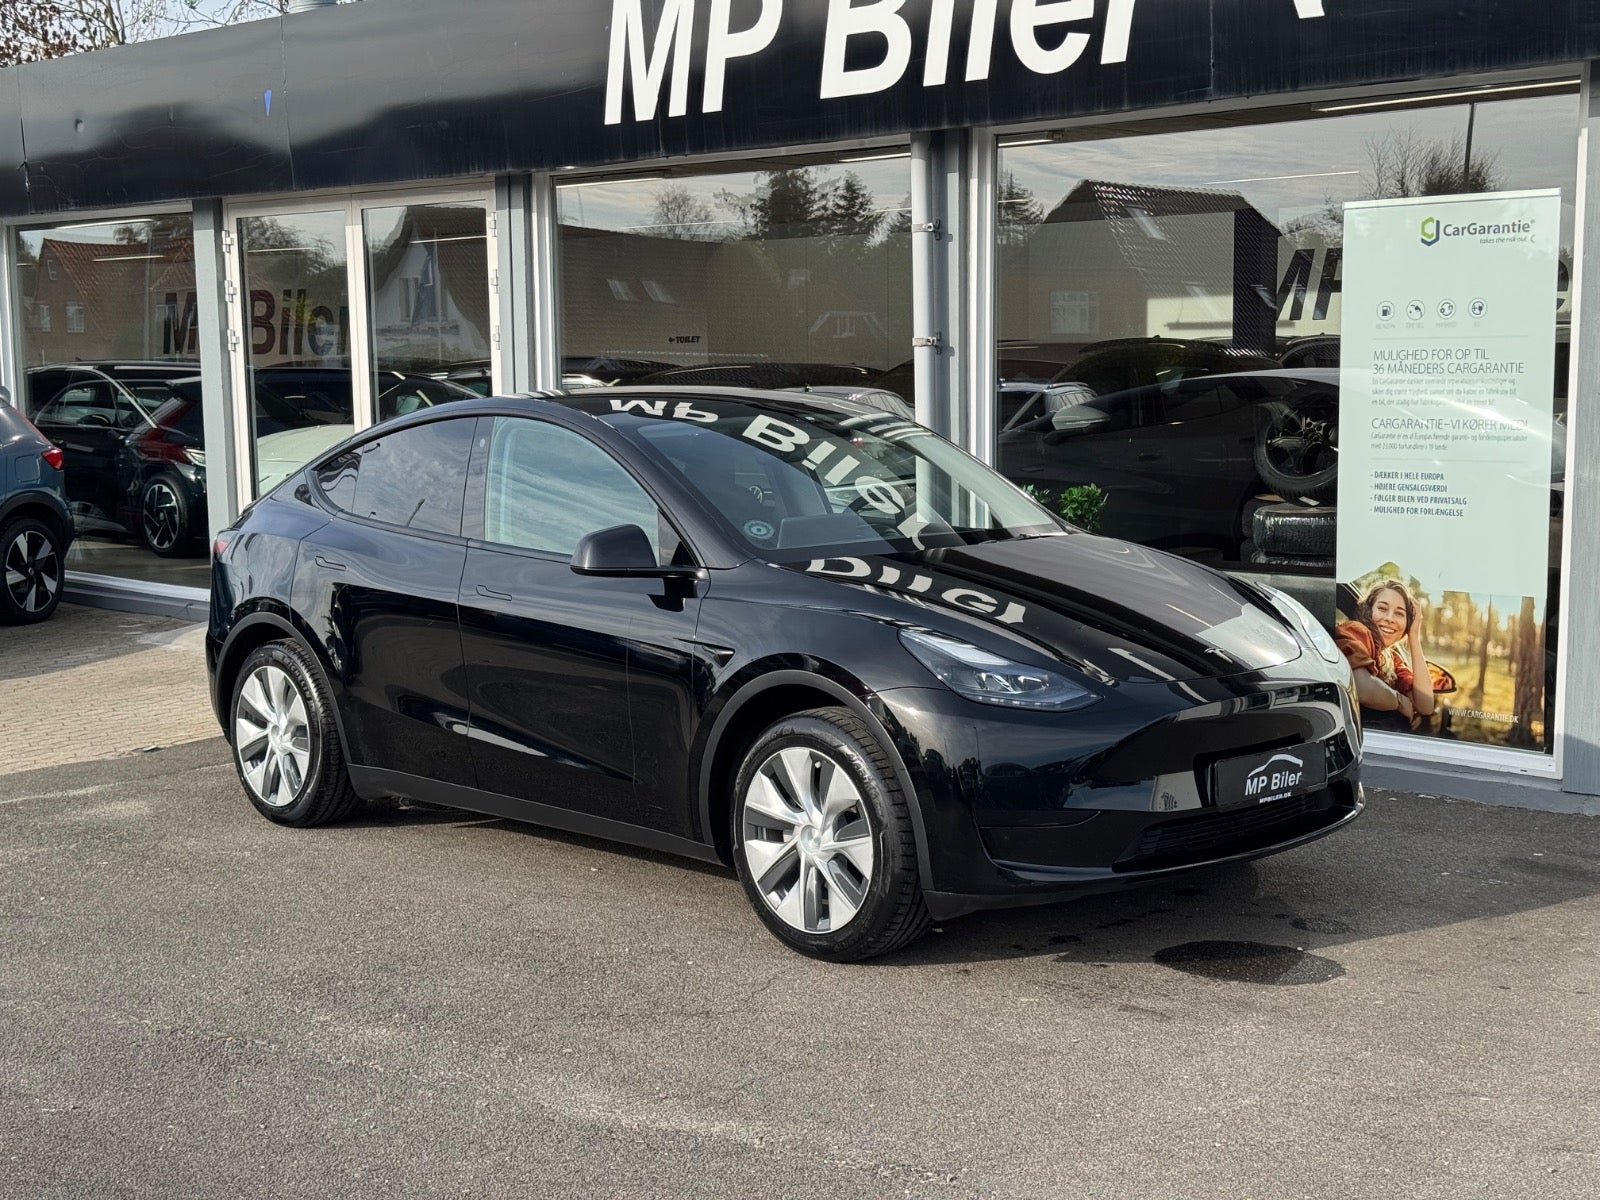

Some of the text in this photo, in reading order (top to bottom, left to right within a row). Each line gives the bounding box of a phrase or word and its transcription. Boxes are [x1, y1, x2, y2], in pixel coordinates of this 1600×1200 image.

[604, 0, 783, 125] MP
[1443, 219, 1530, 236] CarGarantie
[1373, 348, 1489, 361] MULIGHED FOR OP TIL
[1373, 361, 1525, 375] 36 MÅNEDERS CARGARANTIE
[1374, 471, 1399, 480] DÆKKER
[1404, 472, 1420, 480] HELE
[1374, 483, 1448, 492] HØJERE GENSALGSVÆRDI
[1374, 494, 1396, 502] FØLGER
[1397, 495, 1415, 503] BILEN
[1430, 496, 1467, 505] PRIVATSALG
[1374, 506, 1464, 517] MULIGHED FOR FORLÆNGELSE
[1448, 708, 1519, 723] WWW.CARGARANTIE.DK
[1245, 771, 1302, 795] MP Biler
[1259, 792, 1292, 803] MPBILER.DK
